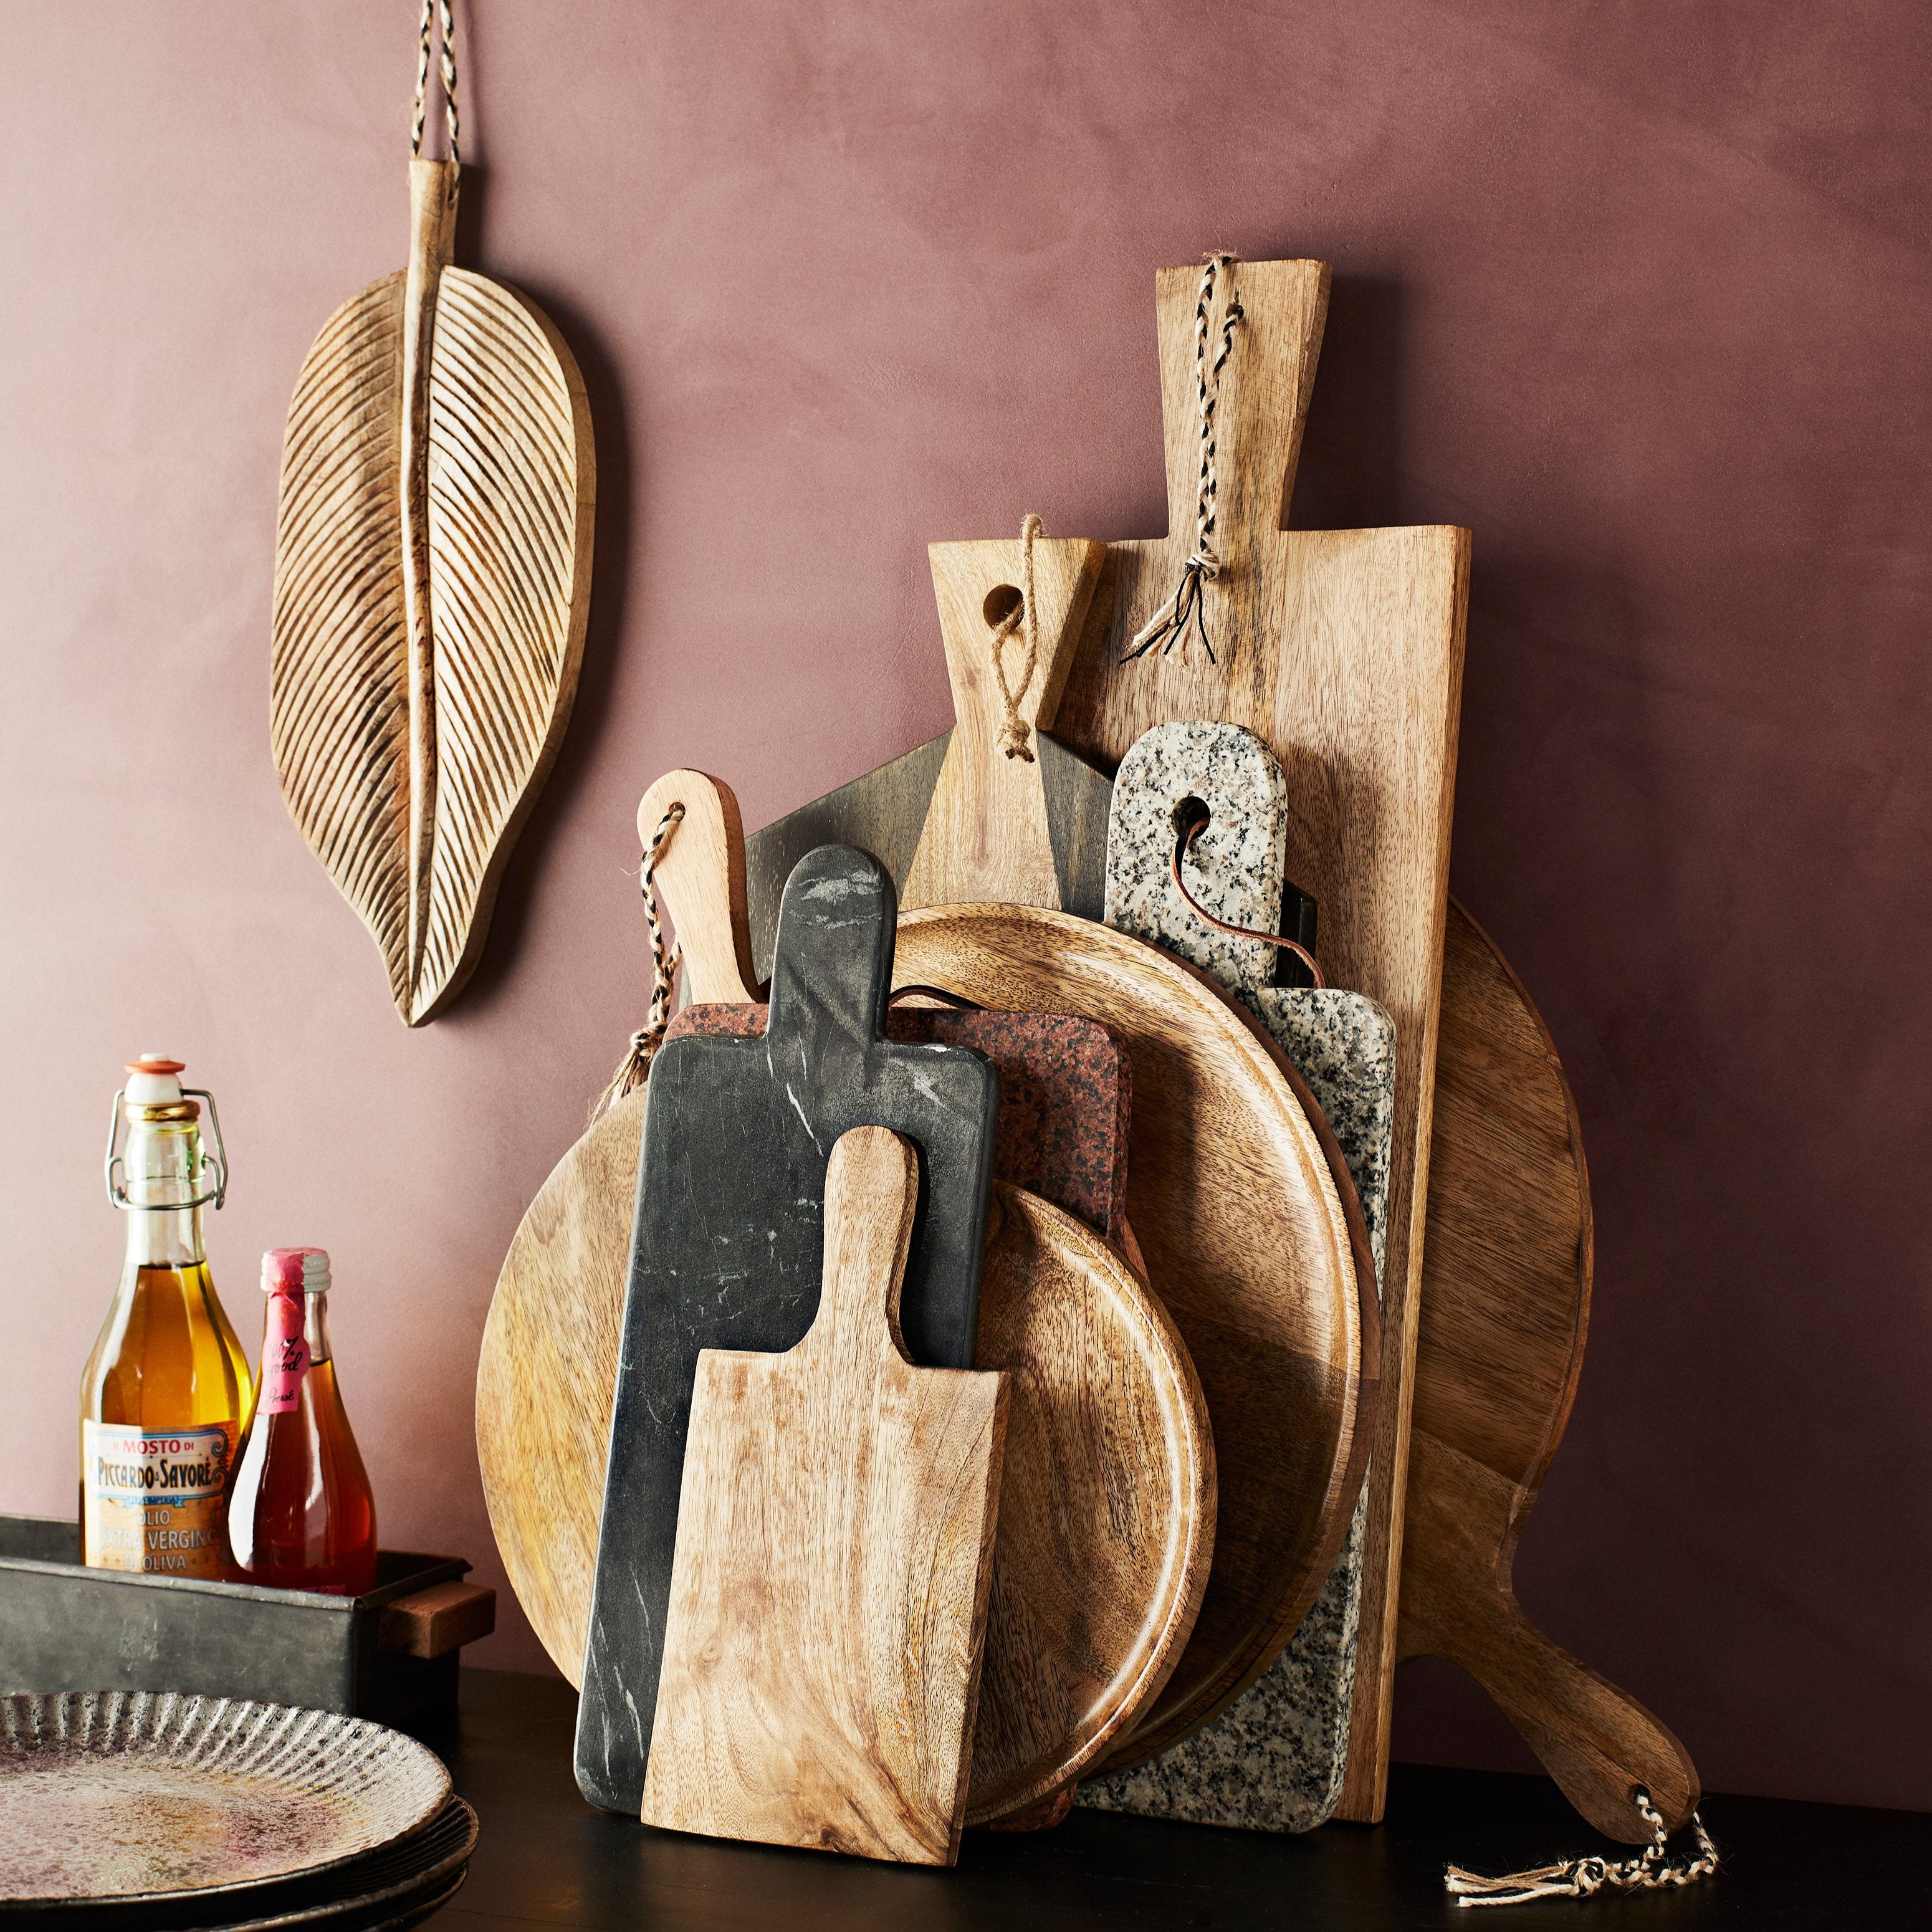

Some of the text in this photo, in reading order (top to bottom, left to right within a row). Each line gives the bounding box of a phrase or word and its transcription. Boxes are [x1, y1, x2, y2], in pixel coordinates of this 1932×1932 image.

[268, 1351, 303, 1382] good
[123, 1439, 181, 1455] MOSTO
[184, 1442, 194, 1451] DI
[136, 1509, 171, 1526] OLIO
[124, 1554, 187, 1571] DI OLIVA
